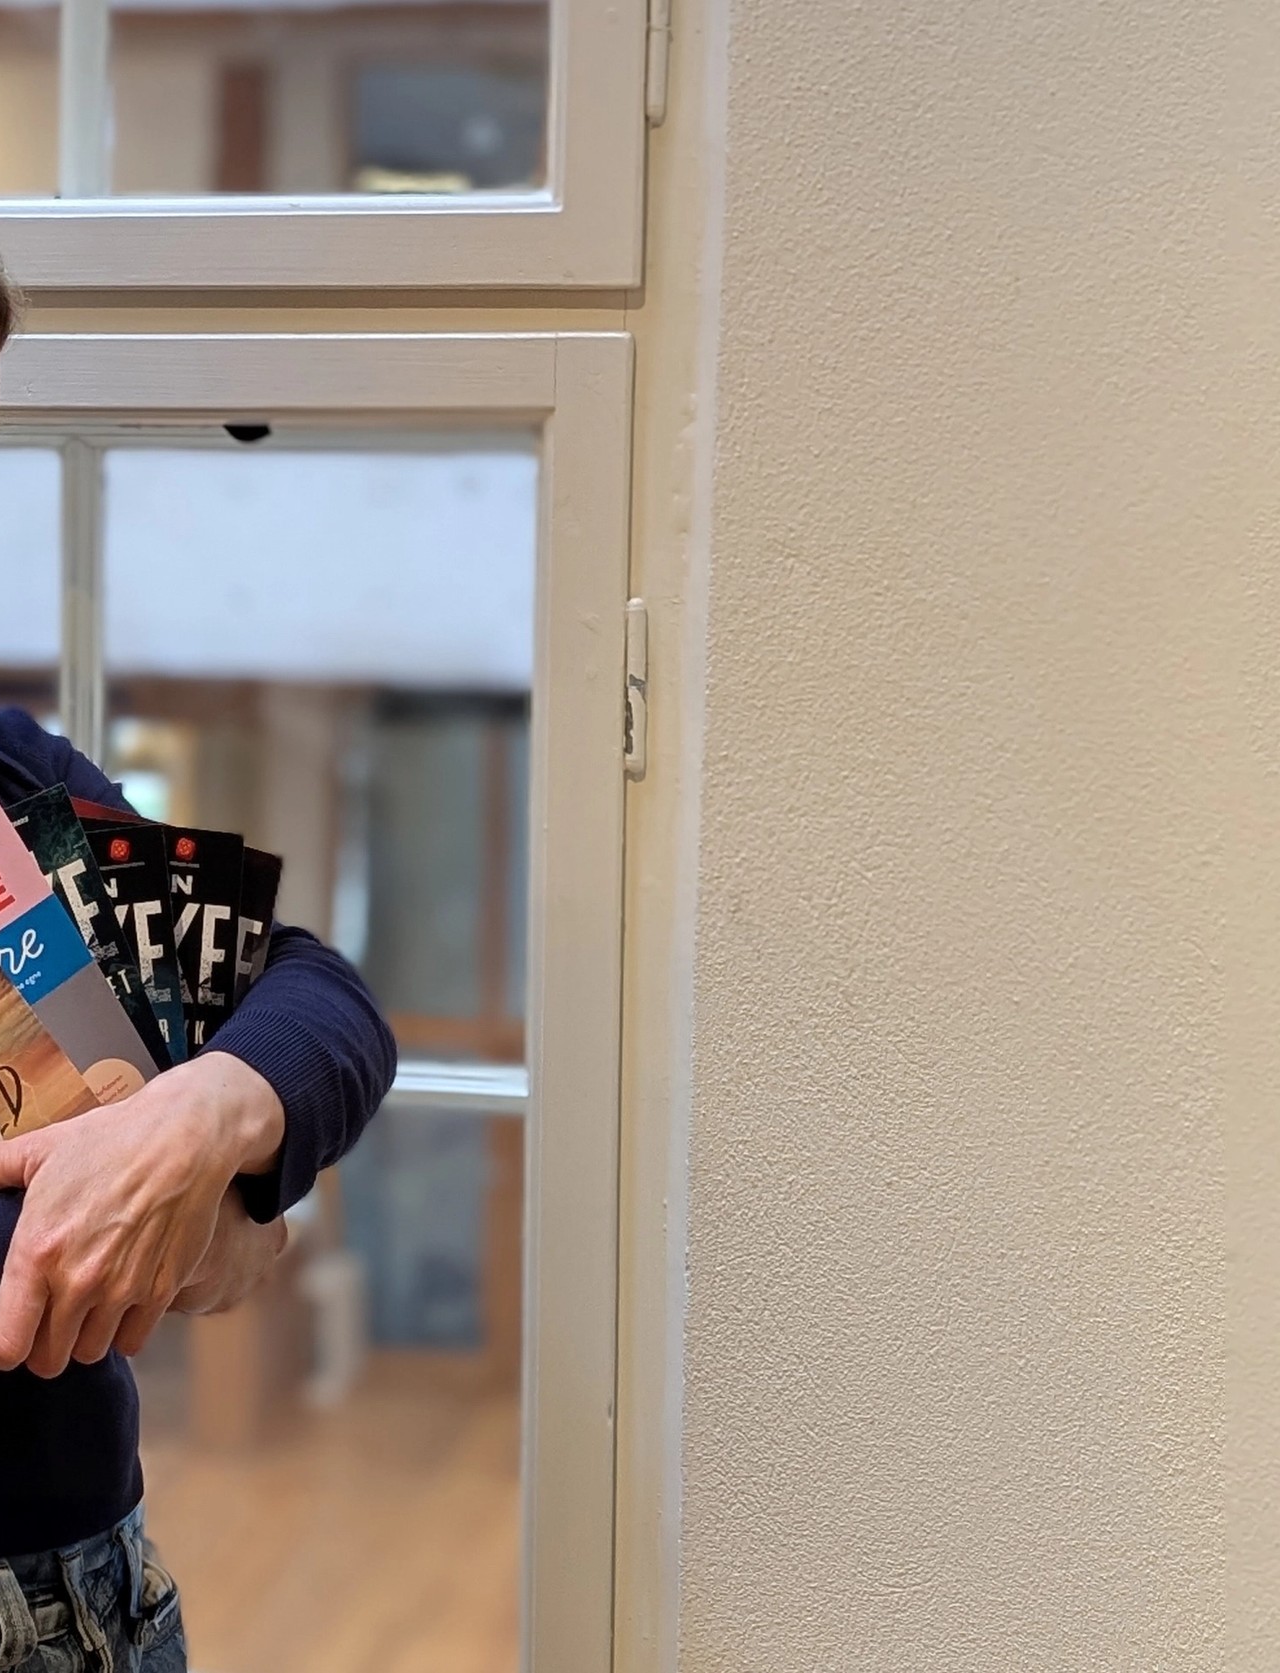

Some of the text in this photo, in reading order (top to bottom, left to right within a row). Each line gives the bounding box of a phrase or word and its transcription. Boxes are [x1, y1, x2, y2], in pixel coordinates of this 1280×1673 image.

[45, 858, 119, 964] E
[171, 874, 194, 895] N
[114, 900, 172, 1004] E
